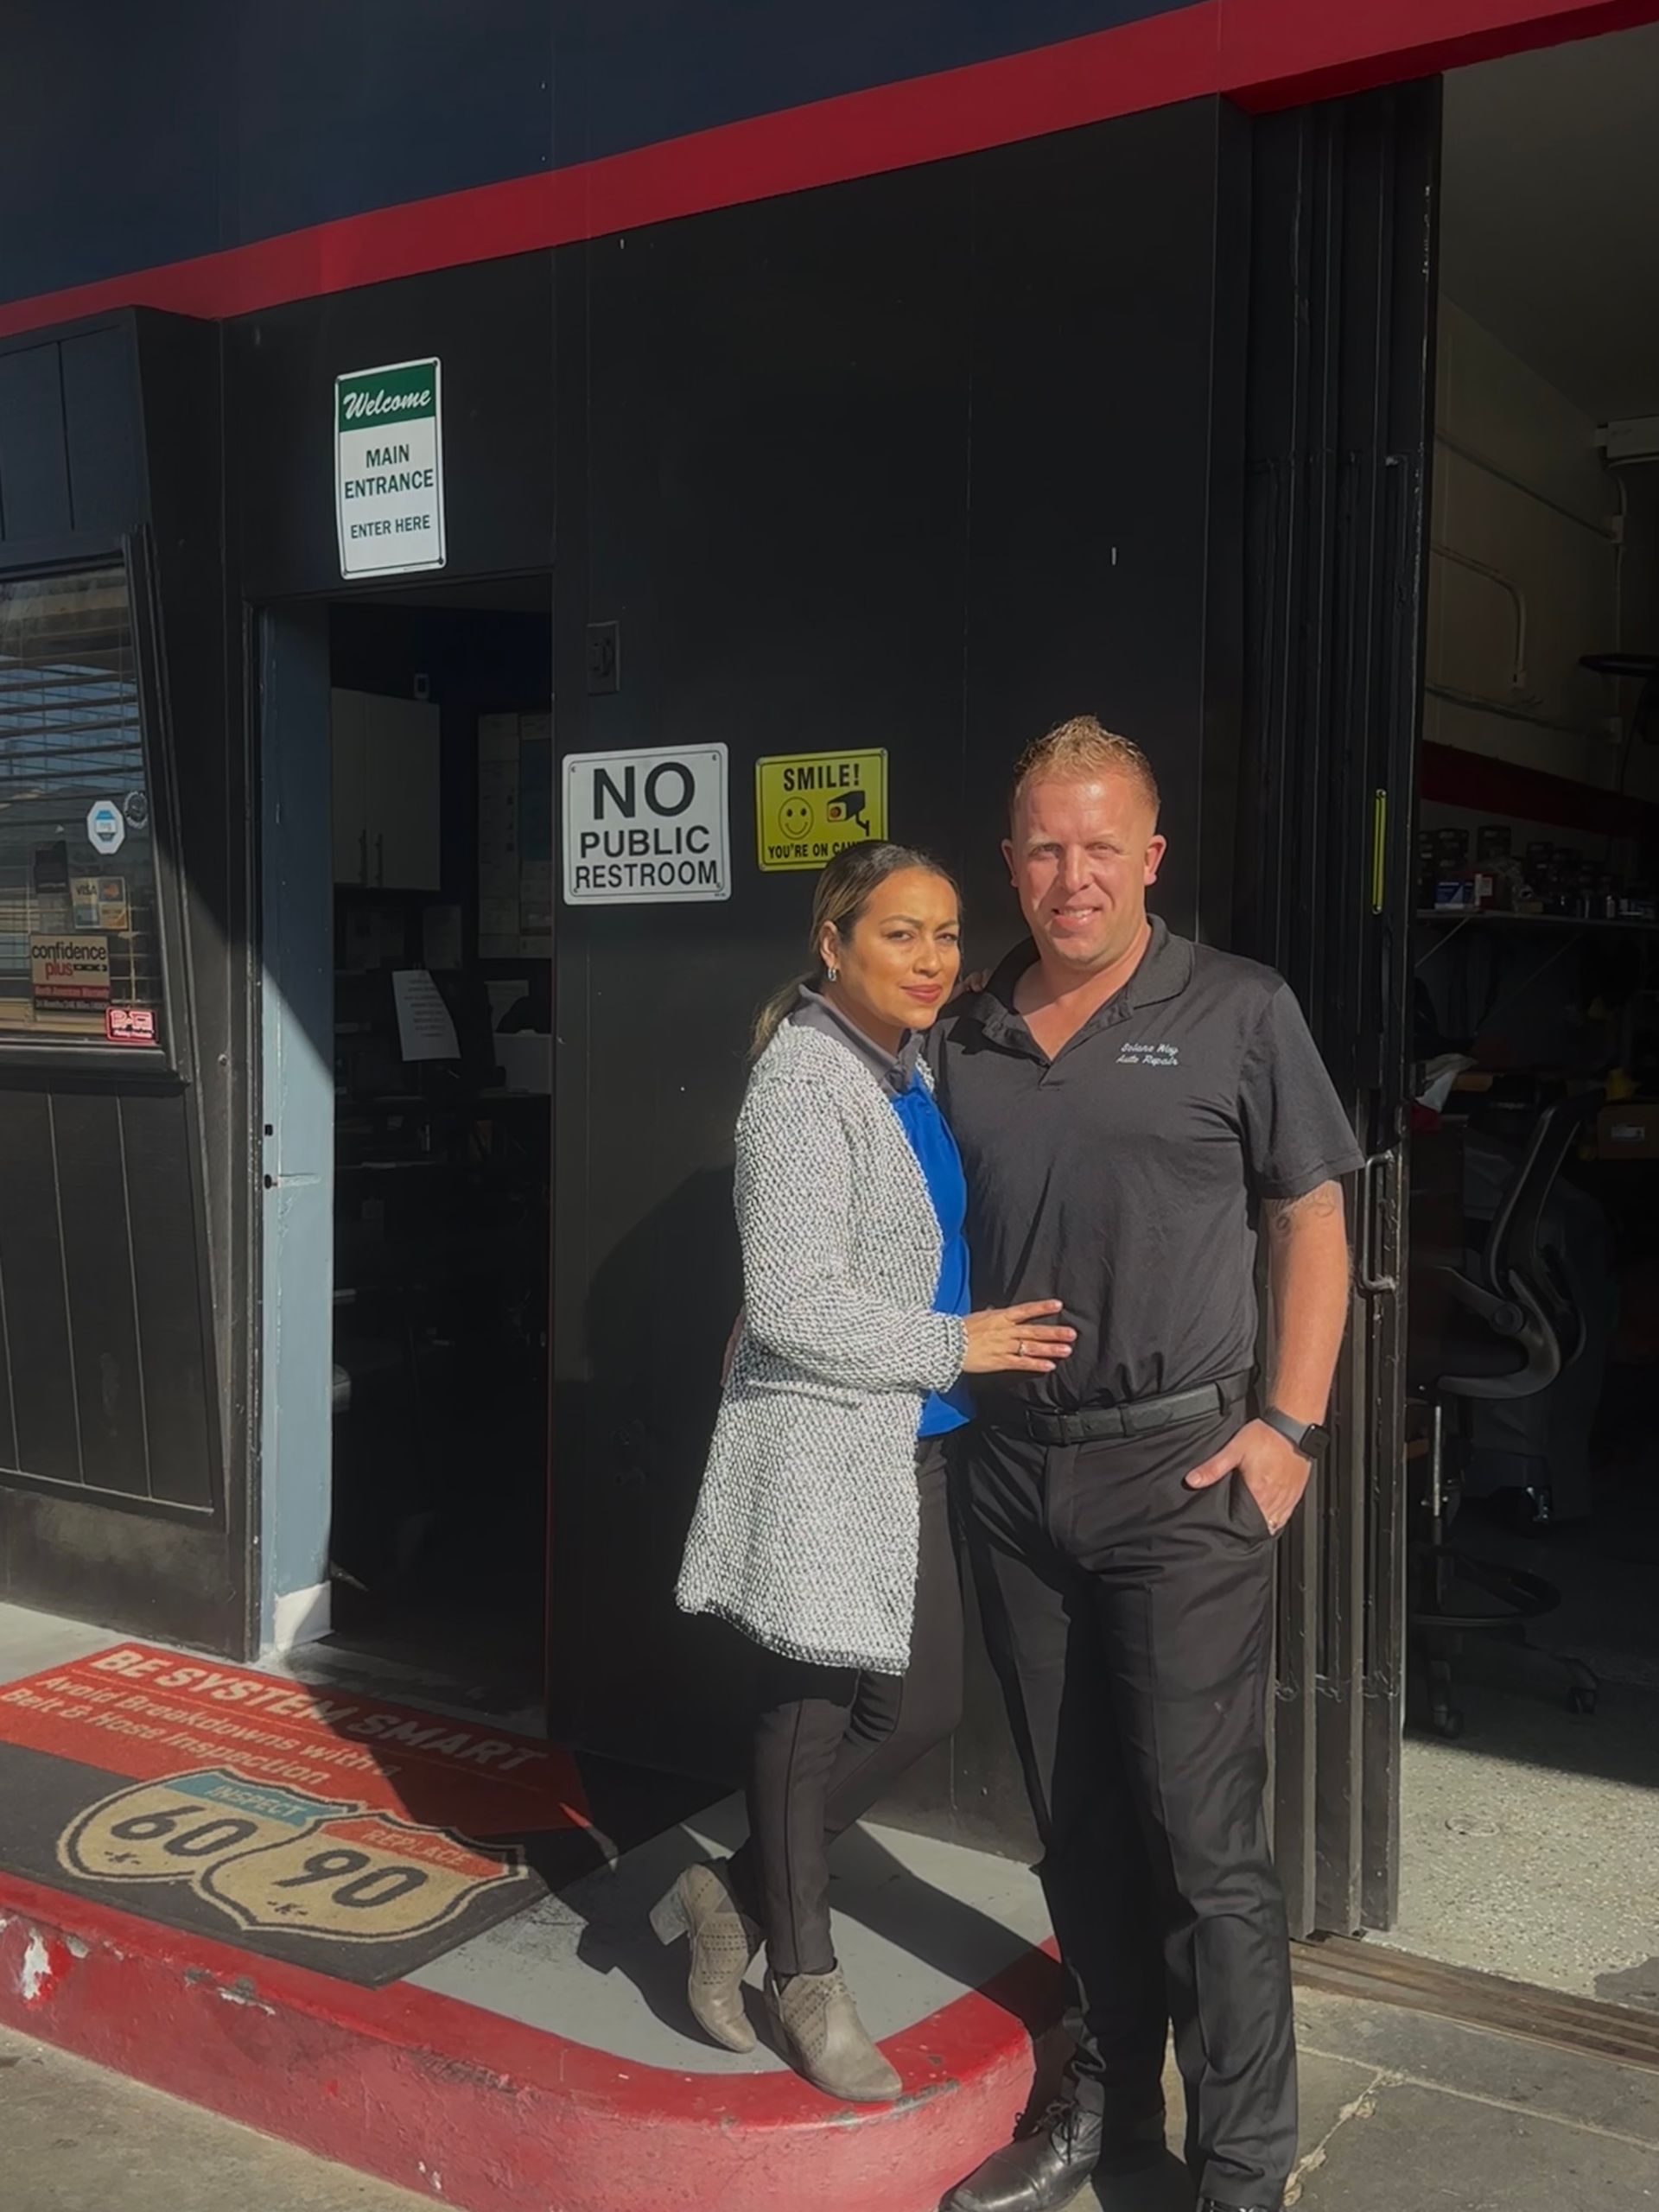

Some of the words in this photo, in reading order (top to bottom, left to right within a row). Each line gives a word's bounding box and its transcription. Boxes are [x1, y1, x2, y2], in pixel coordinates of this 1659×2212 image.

[342, 389, 432, 420] Welcome
[365, 443, 410, 468] MAIN
[344, 468, 435, 499] ENTRANCE
[350, 519, 391, 539] ENTER
[395, 514, 431, 533] HERE
[593, 761, 696, 820] NO
[783, 763, 861, 792] SMILE!
[580, 824, 710, 859] PUBLIC
[767, 843, 809, 860] YOU'RE
[812, 842, 829, 857] ON
[575, 860, 718, 889] RESTROOM
[31, 941, 107, 962] confidence
[45, 959, 74, 981] plus
[1141, 1054, 1179, 1066] Repair
[35, 1675, 121, 1704] Avoid
[118, 1694, 302, 1751] Breakdowns
[299, 1737, 375, 1772] with
[89, 1649, 173, 1678] BE
[154, 1667, 359, 1725] SYSTEM
[346, 1713, 550, 1771] SMART
[1, 1688, 60, 1713] Belt
[57, 1702, 93, 1720] &
[92, 1711, 162, 1741] Hose
[160, 1731, 332, 1786] Inspection
[206, 1784, 308, 1819] INSPECT
[109, 1804, 258, 1858] 60
[362, 1829, 474, 1867] REPLACE
[273, 1848, 430, 1909] 90
